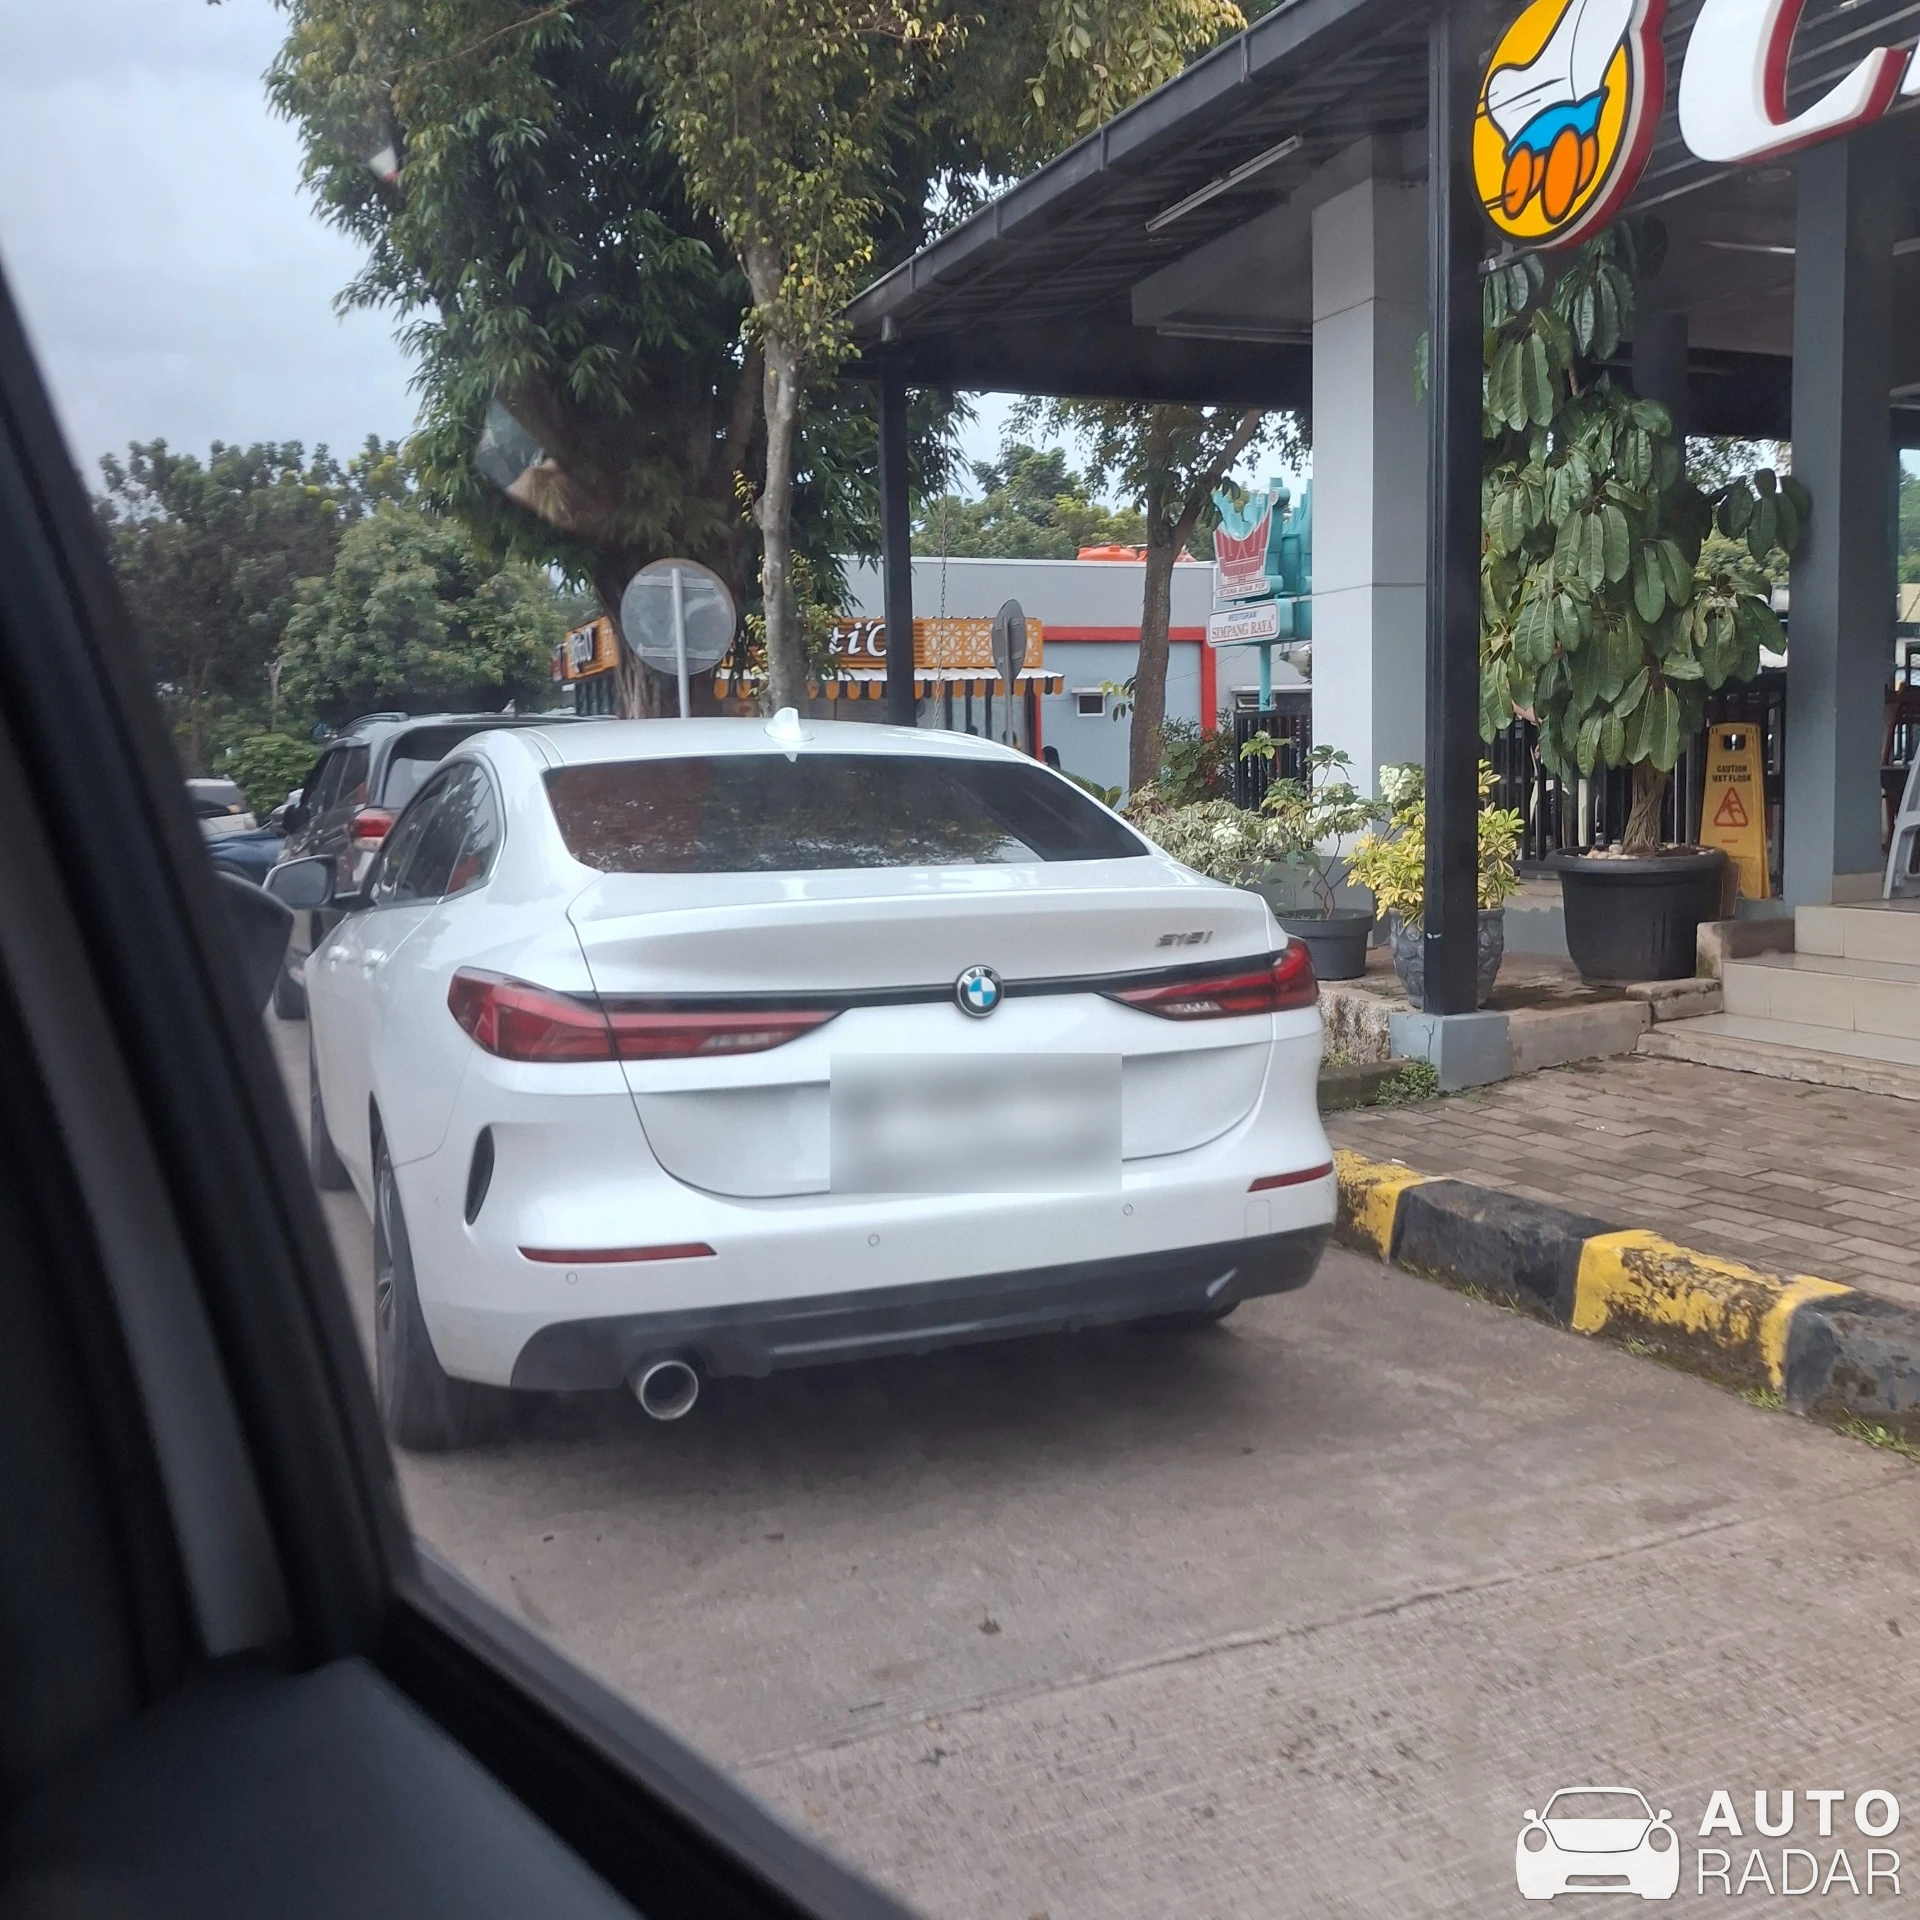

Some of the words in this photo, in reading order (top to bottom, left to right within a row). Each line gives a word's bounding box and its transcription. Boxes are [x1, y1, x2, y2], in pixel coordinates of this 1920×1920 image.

[1211, 622, 1249, 639] SIMPANG
[1250, 620, 1273, 634] RAYA
[1716, 764, 1747, 773] CAUTION
[1712, 774, 1727, 782] WET
[1728, 774, 1751, 782] FLOOR
